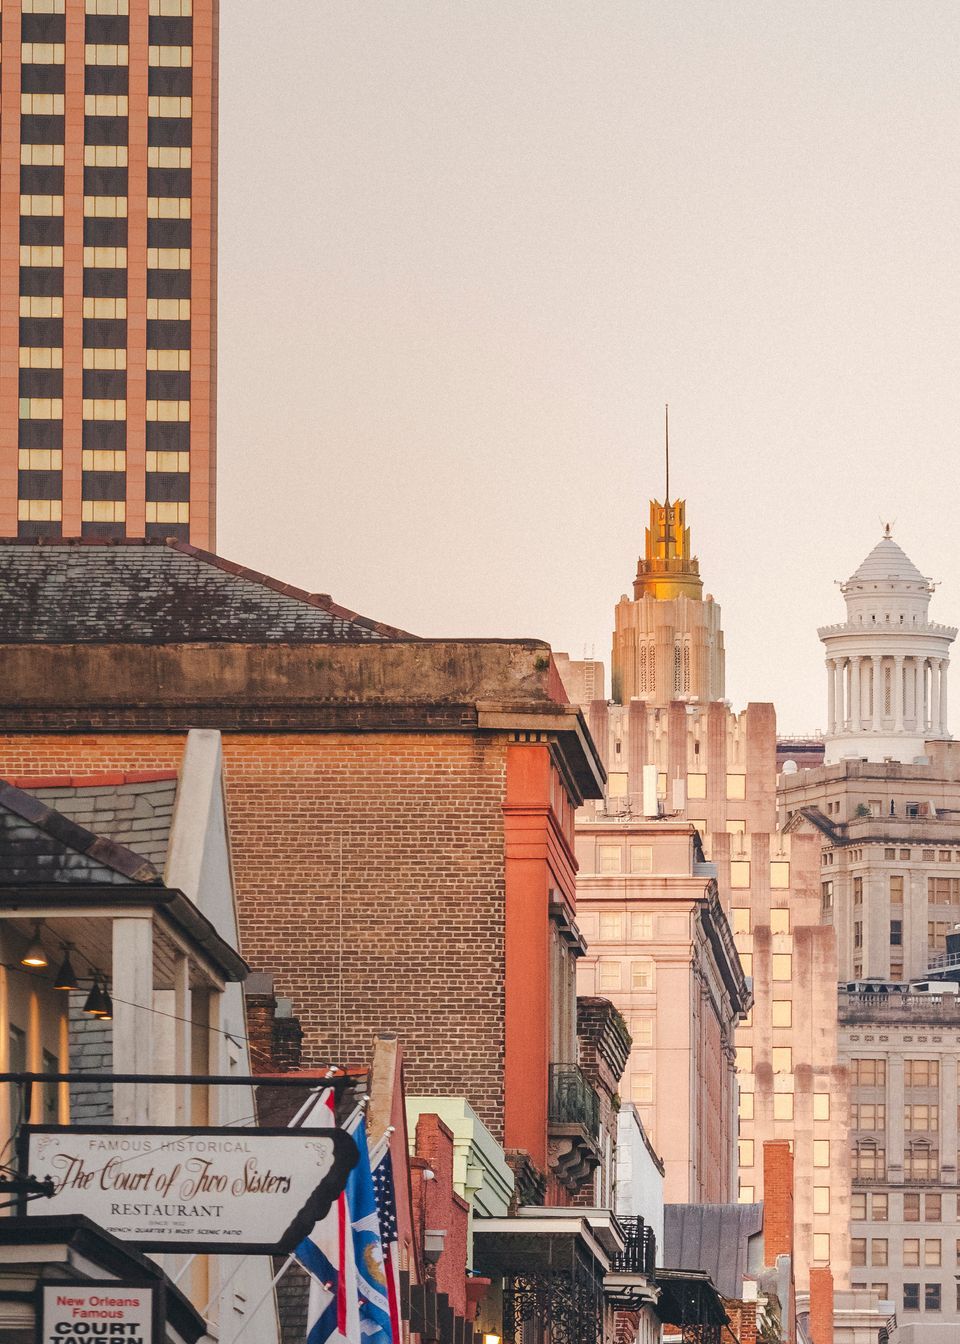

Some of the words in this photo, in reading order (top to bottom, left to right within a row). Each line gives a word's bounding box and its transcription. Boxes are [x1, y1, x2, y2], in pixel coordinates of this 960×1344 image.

[88, 1139, 151, 1152] FAMOUS
[161, 1140, 251, 1153] HISTORICAL
[52, 1153, 95, 1197] The
[100, 1156, 154, 1191] Court
[155, 1163, 182, 1198] of
[179, 1157, 228, 1201] Two
[232, 1157, 292, 1197] Sisters
[111, 1203, 223, 1217] RESTAURANT
[57, 1296, 84, 1306] New
[89, 1296, 140, 1307] Orleans
[72, 1308, 124, 1319] Famous
[55, 1322, 140, 1335] COURT
